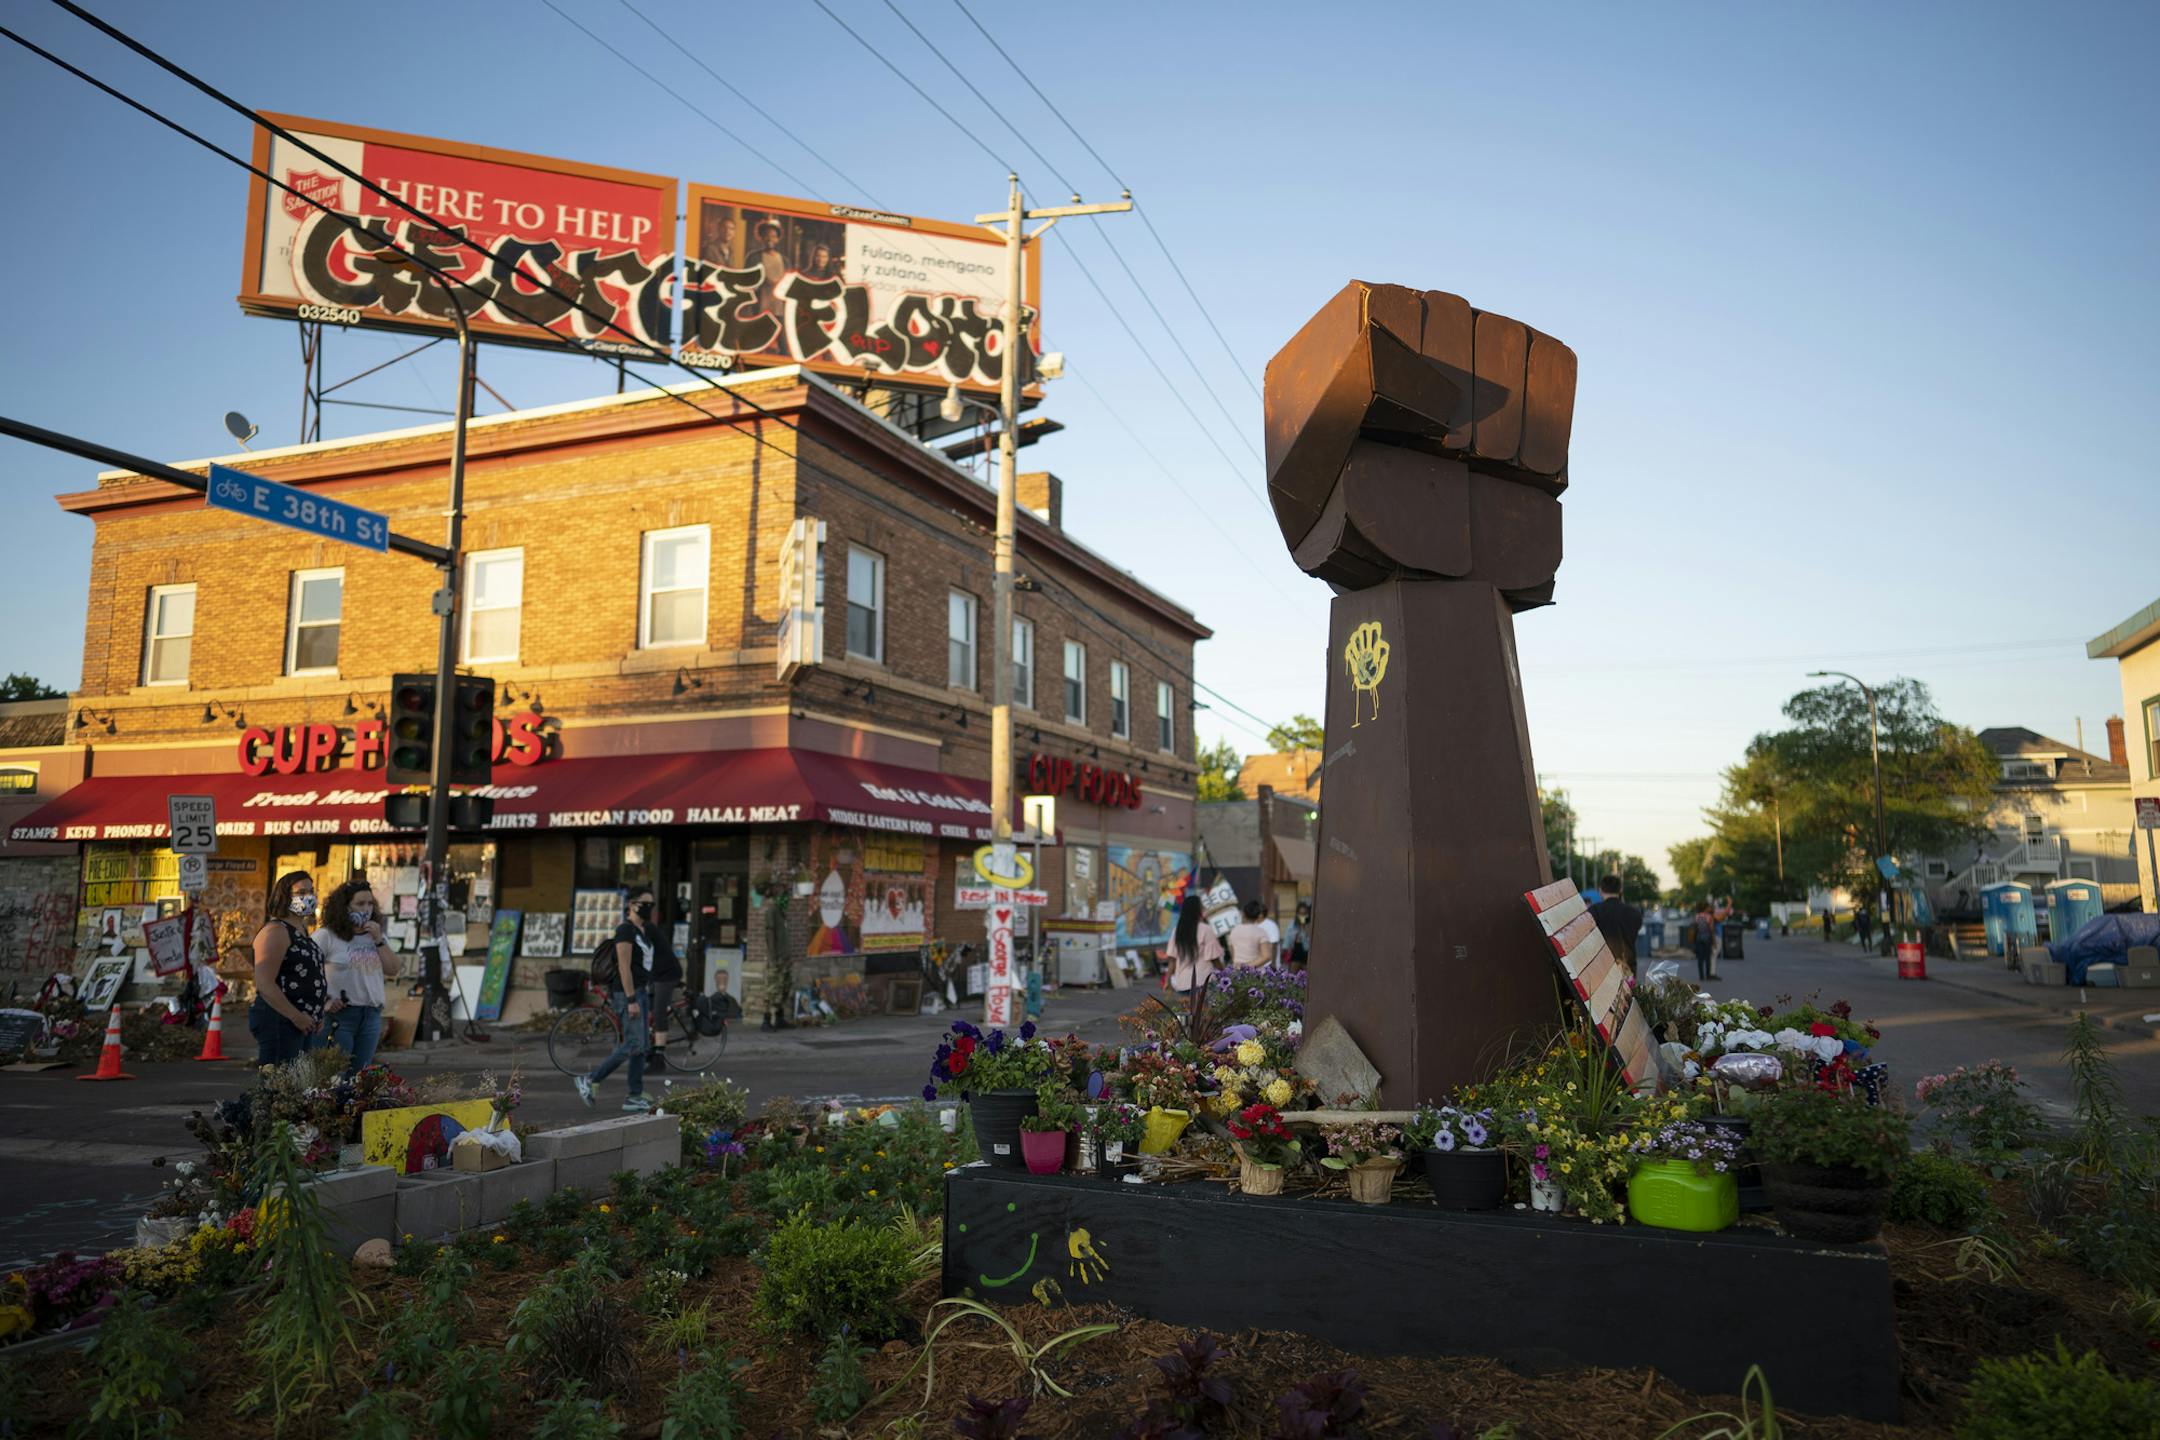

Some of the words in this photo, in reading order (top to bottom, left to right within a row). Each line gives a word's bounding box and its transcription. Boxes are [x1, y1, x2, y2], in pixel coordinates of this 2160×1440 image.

[295, 175, 319, 191] THE
[377, 177, 484, 221] HERE
[494, 198, 545, 231] TO
[556, 203, 653, 245] HELP
[861, 263, 872, 276] y
[921, 255, 996, 276] mengano
[298, 304, 360, 325] 032540
[679, 351, 734, 370] 032570
[252, 485, 271, 512] E
[283, 495, 346, 533] 38th
[356, 516, 383, 544] St
[238, 722, 338, 777] CUP
[1029, 751, 1075, 799] CUP
[1079, 762, 1143, 811] FOODS
[174, 801, 211, 812] SPEED
[686, 807, 746, 824] HALAL
[749, 804, 801, 823] MEAT
[178, 814, 208, 823] LIMIT
[263, 821, 291, 835] BUS
[293, 819, 340, 834] CARDS
[548, 811, 625, 828] MEXICAN
[627, 809, 675, 826] FOOD
[828, 807, 866, 827] MIDDLE
[867, 814, 910, 832] EASTERN
[909, 820, 934, 836] FOOD
[12, 827, 59, 839] STAMPS
[65, 826, 97, 839] KEYS
[103, 824, 153, 839] PHONES
[177, 826, 213, 847] 25
